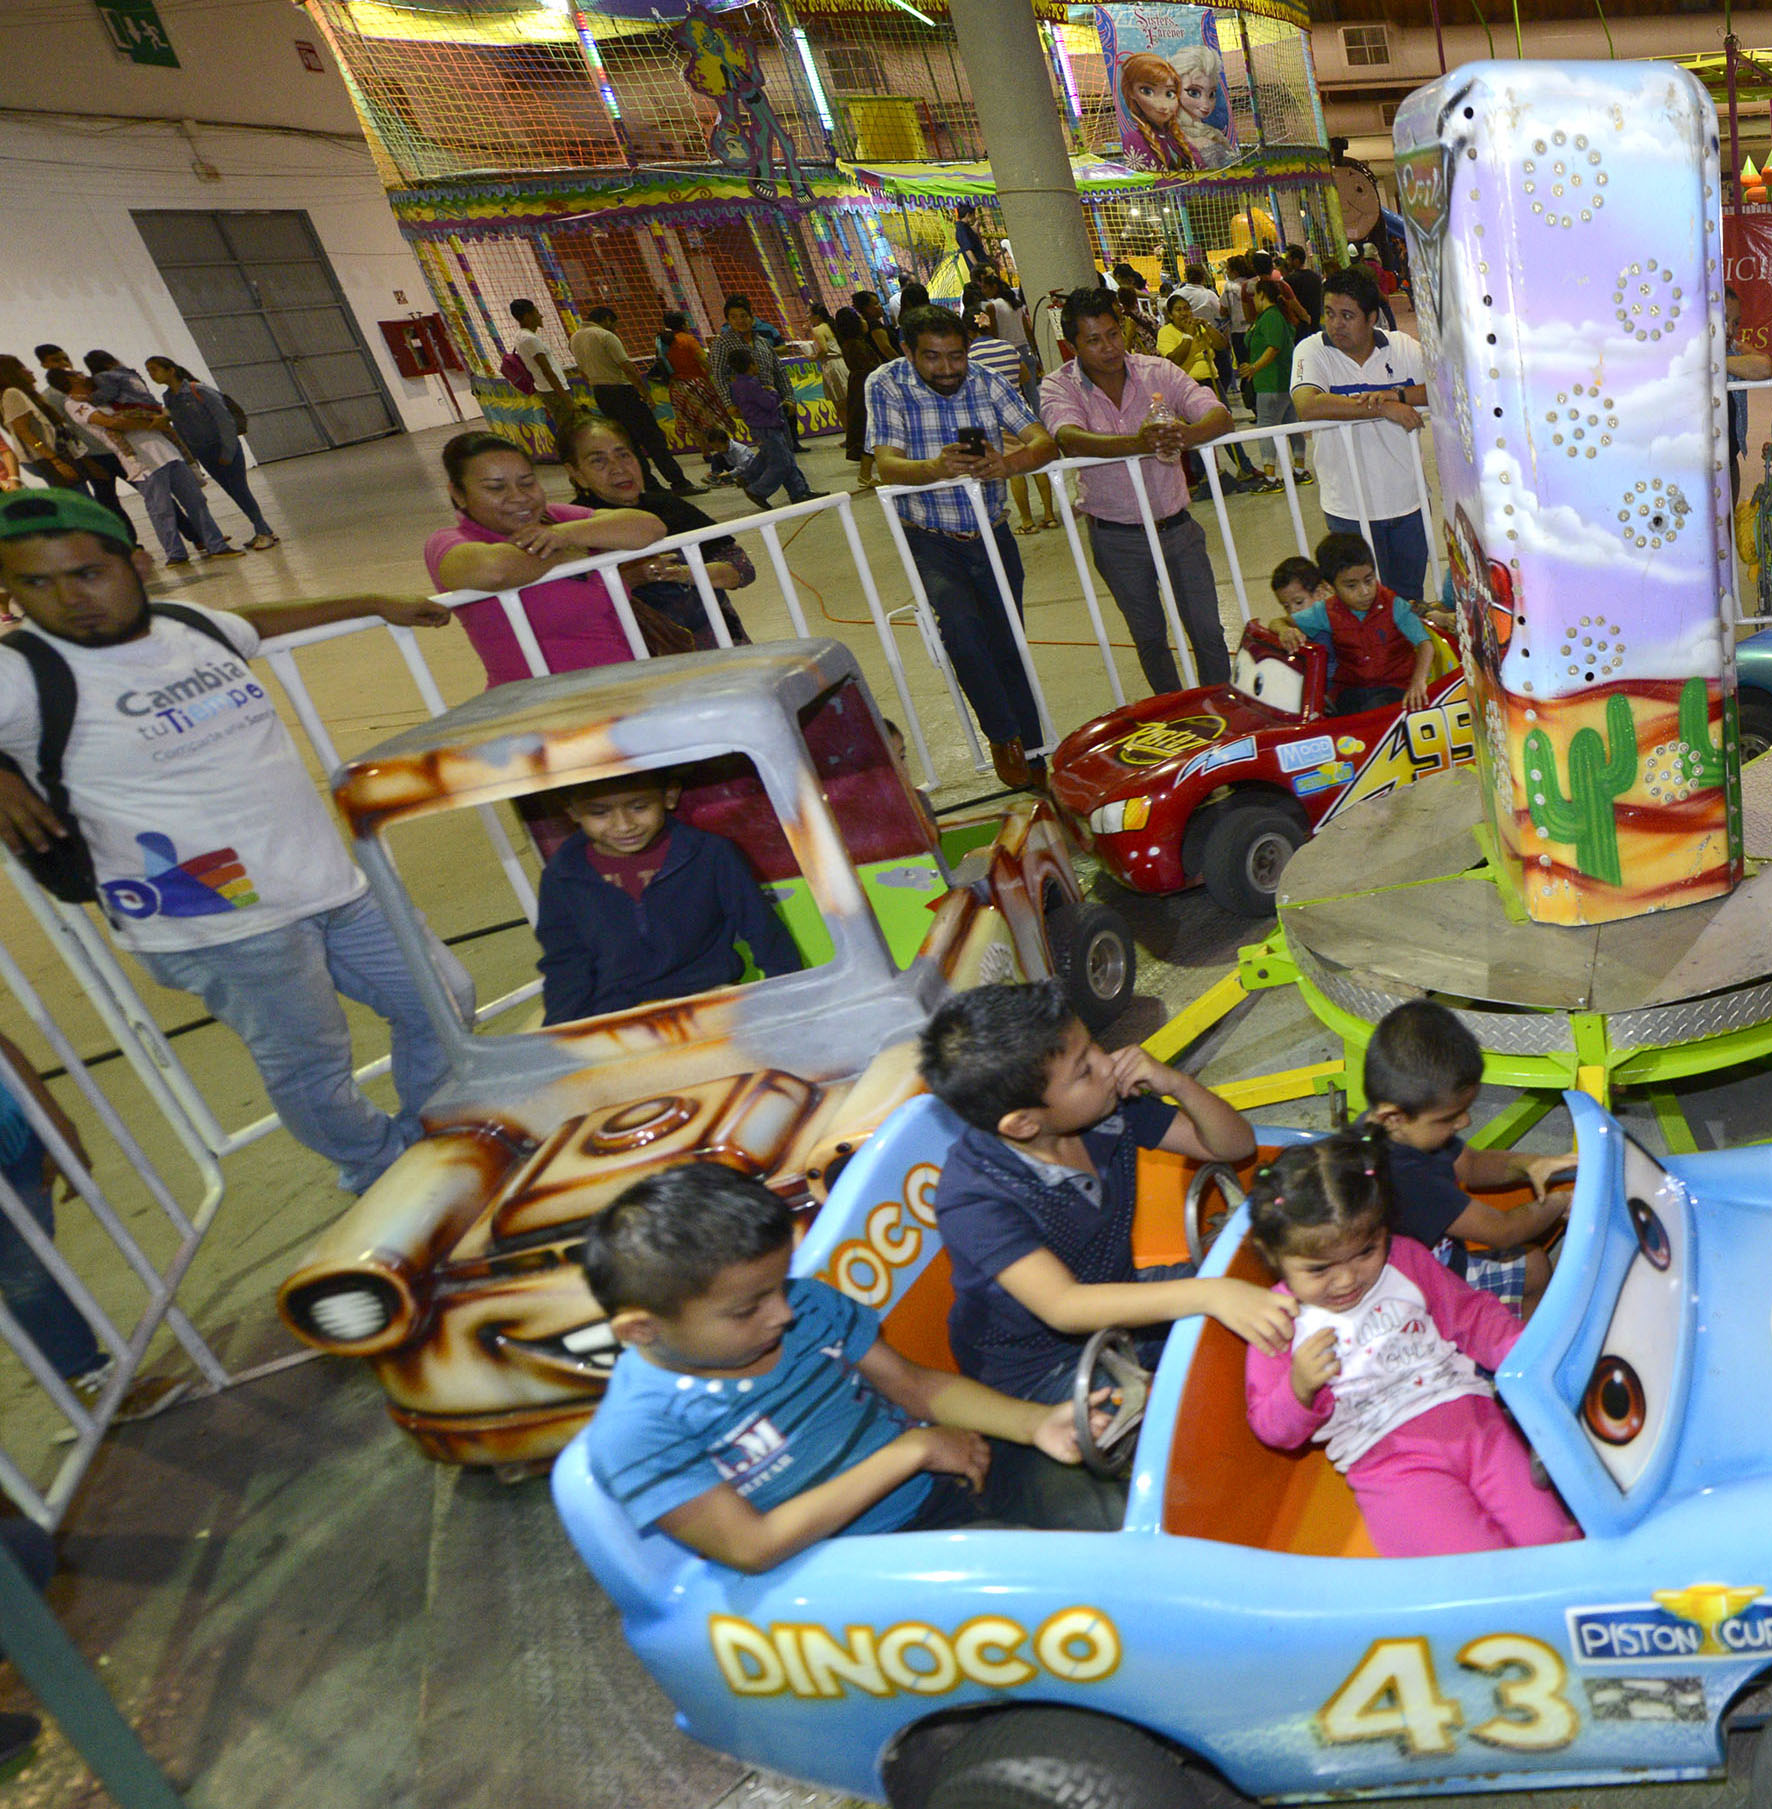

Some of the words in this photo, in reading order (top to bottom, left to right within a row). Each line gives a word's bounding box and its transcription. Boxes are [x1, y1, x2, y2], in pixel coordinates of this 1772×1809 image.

[115, 661, 246, 717] Cambia
[708, 1606, 1122, 1696] DINOCO
[1580, 1621, 1699, 1658] PISTON
[1314, 1632, 1582, 1757] 43
